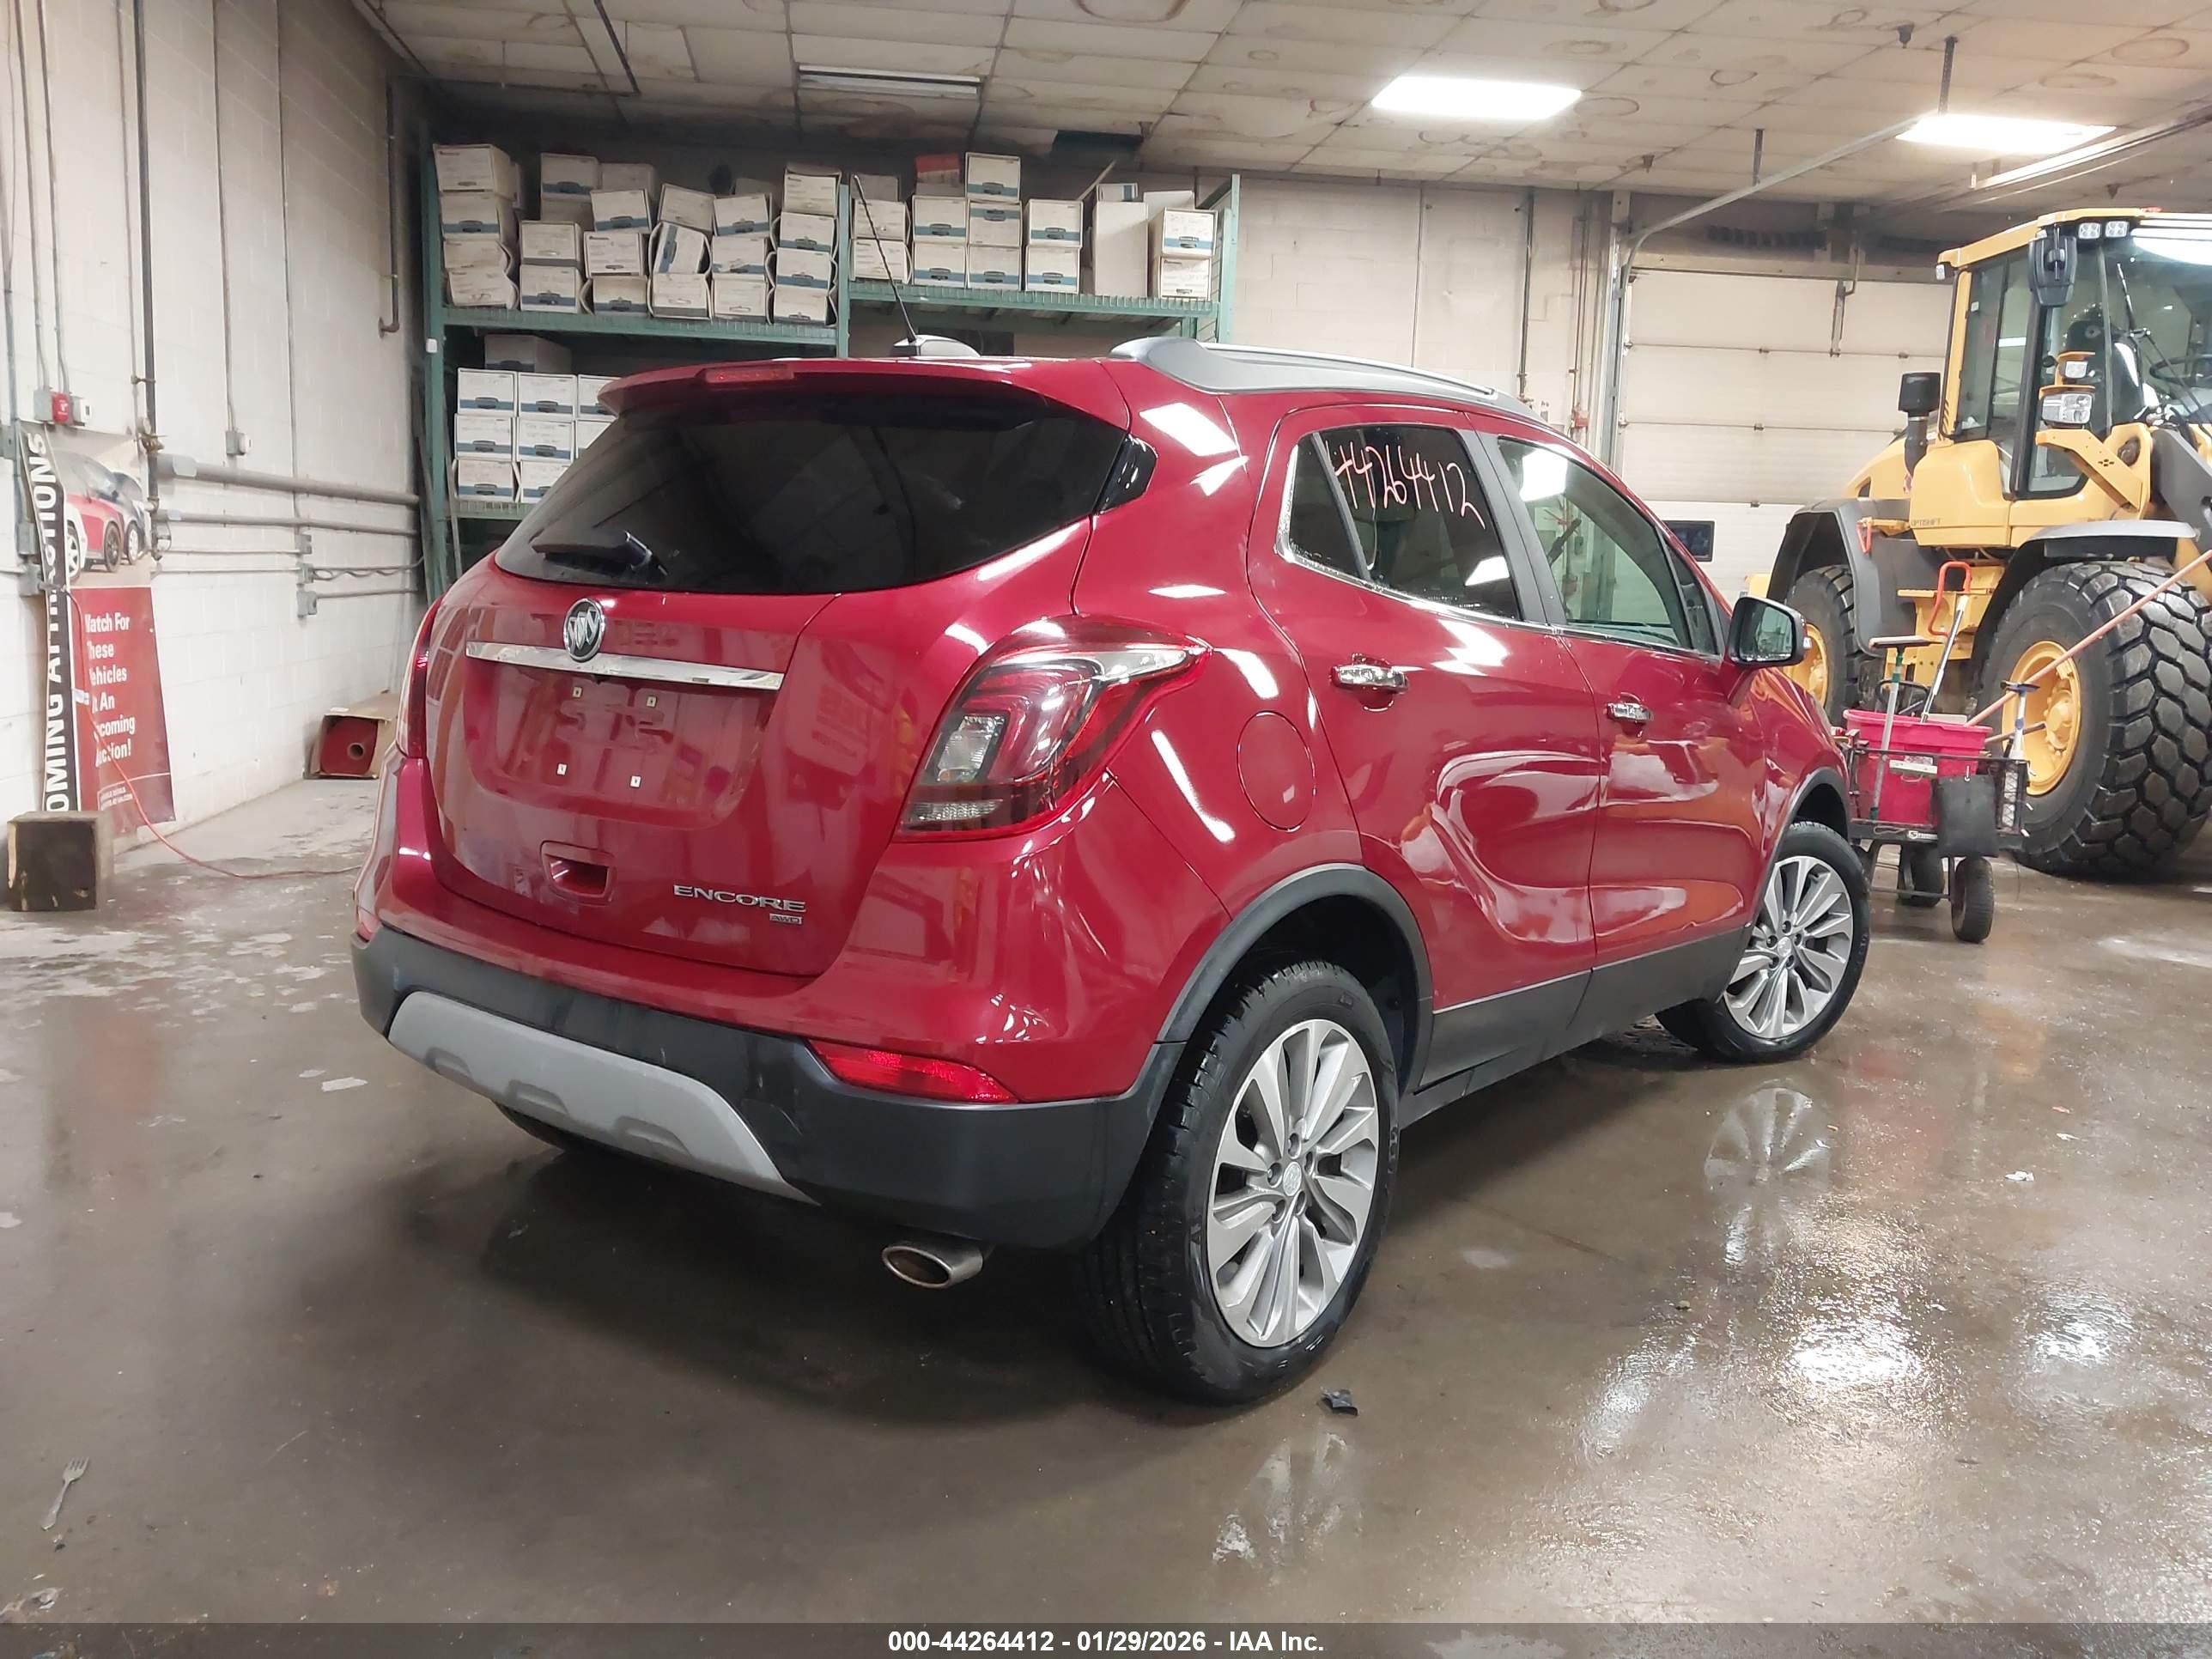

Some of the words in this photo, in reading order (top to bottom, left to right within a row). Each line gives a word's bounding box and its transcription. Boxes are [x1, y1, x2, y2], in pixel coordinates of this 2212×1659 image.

[114, 611, 131, 631] For
[100, 691, 115, 712] An
[94, 714, 136, 739] coming
[46, 693, 70, 812] OMING
[673, 884, 806, 913] ENCORE
